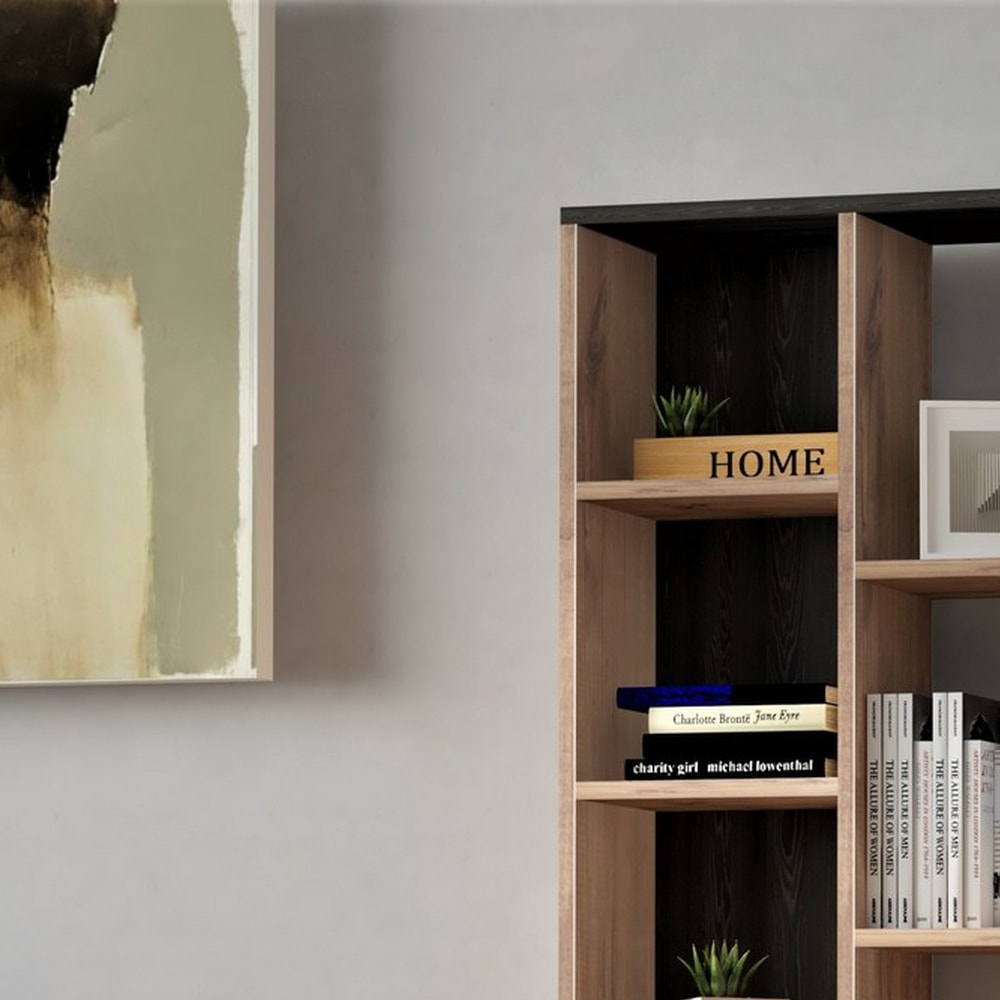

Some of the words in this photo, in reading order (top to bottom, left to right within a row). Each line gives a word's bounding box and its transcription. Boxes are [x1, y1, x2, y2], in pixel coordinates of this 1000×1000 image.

[709, 448, 825, 478] HOME
[673, 713, 717, 726] Charlotte
[753, 709, 776, 725] Jane
[778, 709, 801, 723] Eyre
[633, 761, 675, 776] charity
[677, 761, 699, 776] girl
[707, 760, 753, 773] michael
[756, 759, 814, 772] lowenthal
[869, 760, 878, 780] THE
[885, 760, 894, 780] THE
[900, 760, 909, 780] THE
[936, 759, 944, 779] THE
[951, 759, 959, 779] THE
[869, 782, 878, 821] ALLURE
[885, 782, 894, 821] ALLURE
[900, 782, 909, 821] ALLURE
[936, 780, 944, 820] ALLURE
[951, 780, 959, 820] ALLURE
[869, 822, 878, 836] OF
[885, 822, 894, 836] OF
[900, 822, 909, 836] OF
[936, 822, 944, 835] OF
[951, 822, 959, 835] OF
[869, 838, 878, 876] WOMEN
[885, 838, 894, 876] WOMEN
[900, 838, 909, 858] MEN
[936, 837, 944, 875] WOMEN
[951, 837, 959, 858] MEN
